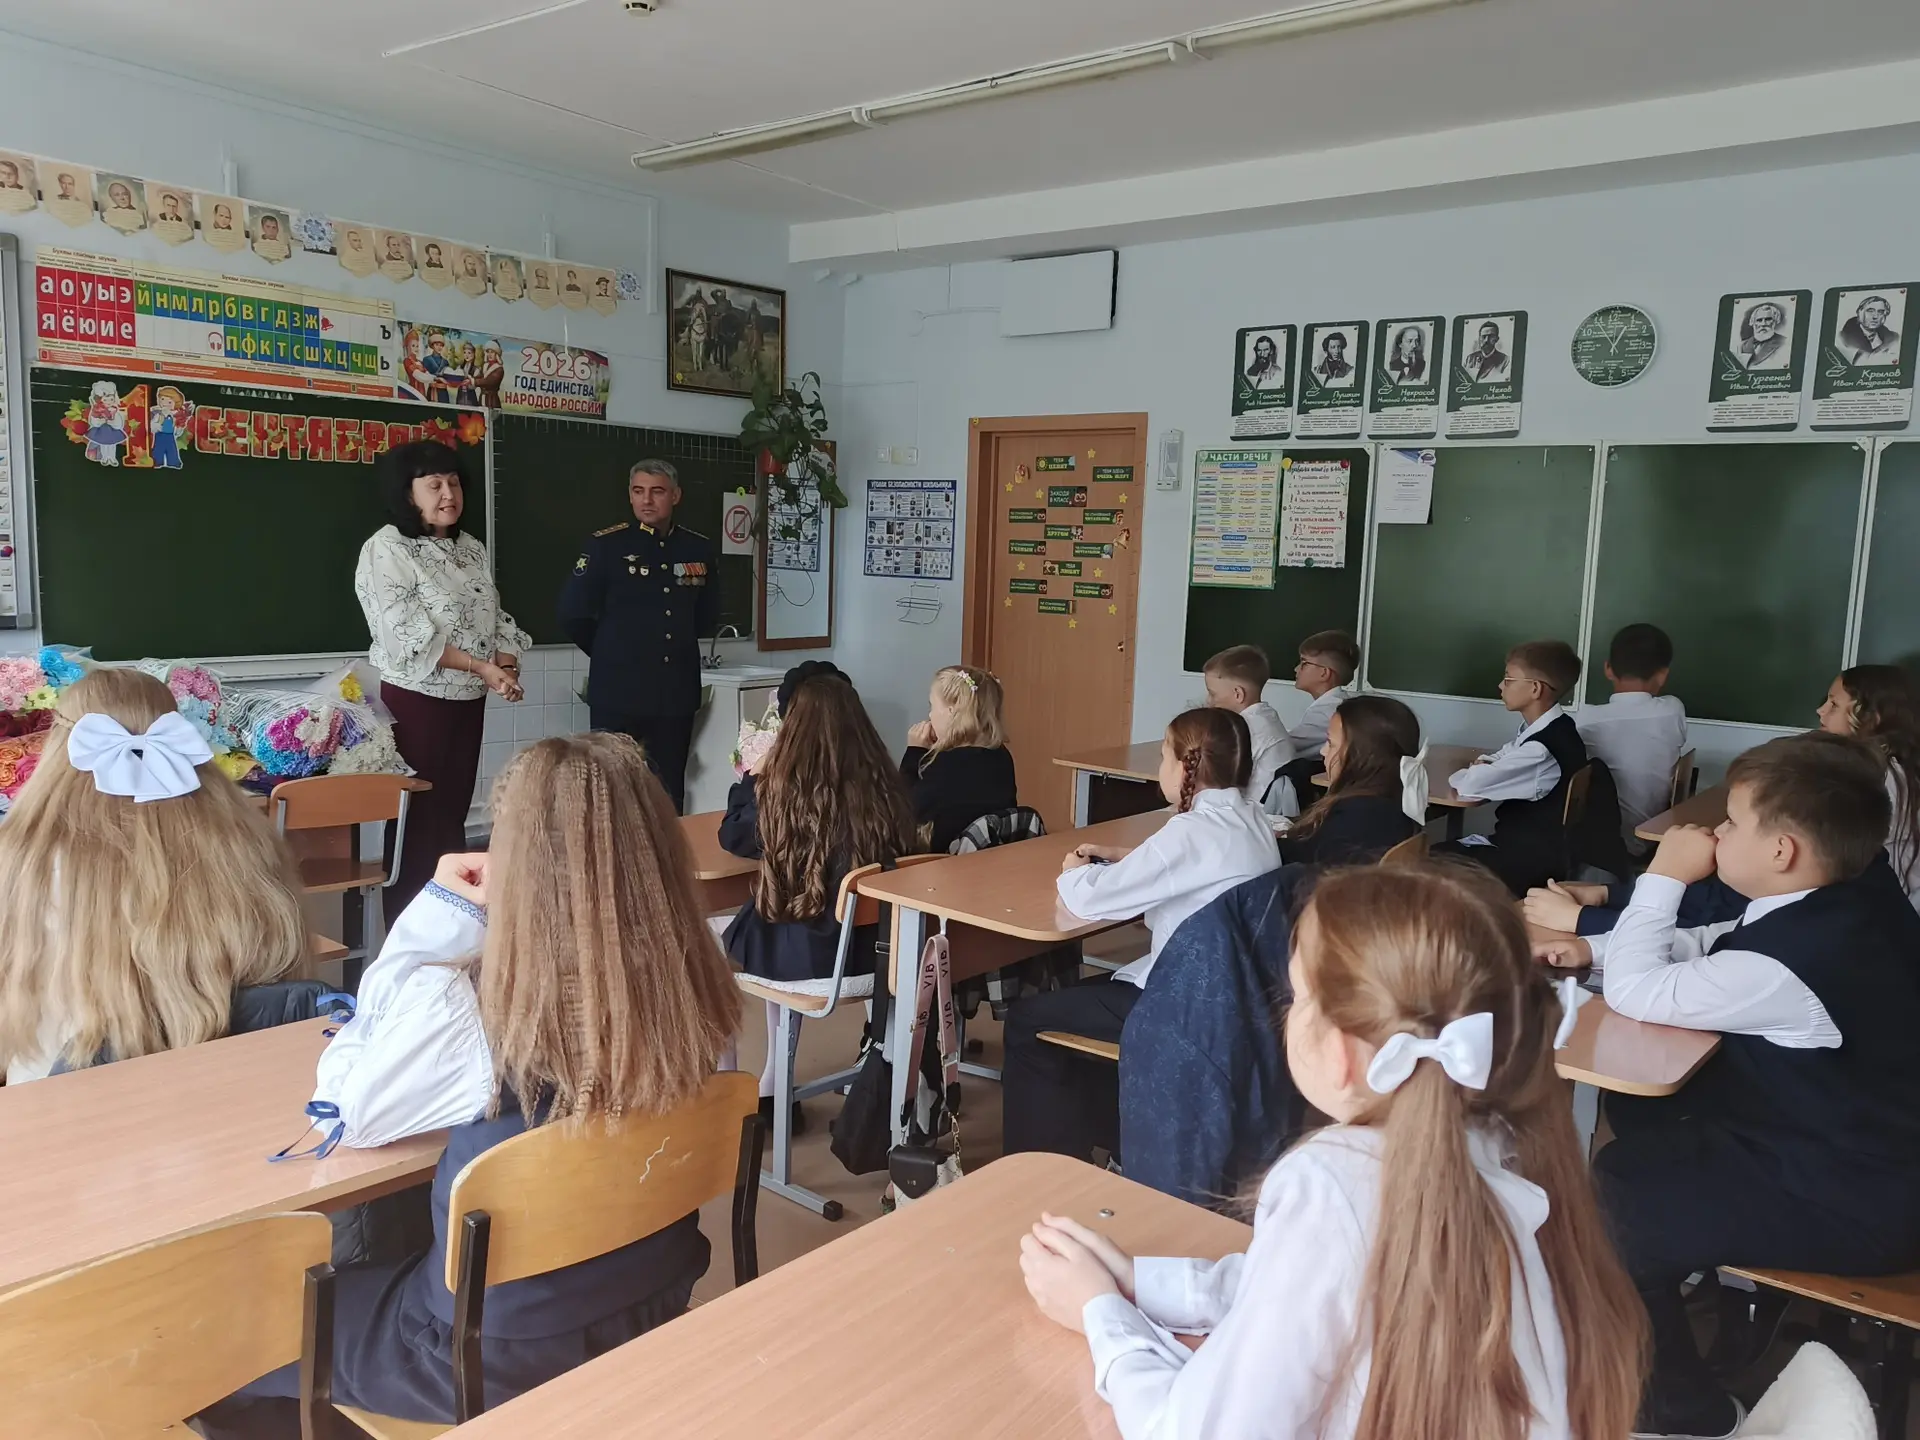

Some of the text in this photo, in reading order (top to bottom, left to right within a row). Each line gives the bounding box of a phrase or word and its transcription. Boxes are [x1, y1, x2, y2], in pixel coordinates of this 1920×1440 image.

[40, 275, 319, 330] а о у ы э й н м л р б в г д з ж
[42, 310, 133, 340] я ё ю и е
[226, 335, 238, 351] п
[241, 332, 256, 359] ф
[260, 339, 271, 355] к
[277, 342, 287, 357] т
[292, 345, 301, 360] с
[305, 347, 319, 362] ш
[323, 349, 333, 364] х
[337, 351, 348, 369] ц
[352, 352, 362, 367] ч
[364, 355, 377, 372] щ
[521, 346, 592, 381] 2026
[1747, 372, 1792, 384] Тургенев
[1861, 368, 1901, 381] Крылов
[514, 375, 594, 397] ГОД ЕДИНСТВА
[1489, 385, 1512, 393] Чехов
[1751, 382, 1791, 391] Сергеевич
[1856, 378, 1901, 388] Андреевич
[1332, 390, 1361, 400] Пушкин
[1400, 388, 1436, 398] Некрасов
[505, 391, 602, 415] НАРОДОВ РОССИИ
[119, 384, 153, 467] 1
[1210, 453, 1268, 461] ЧАСТИ РЕЧИ
